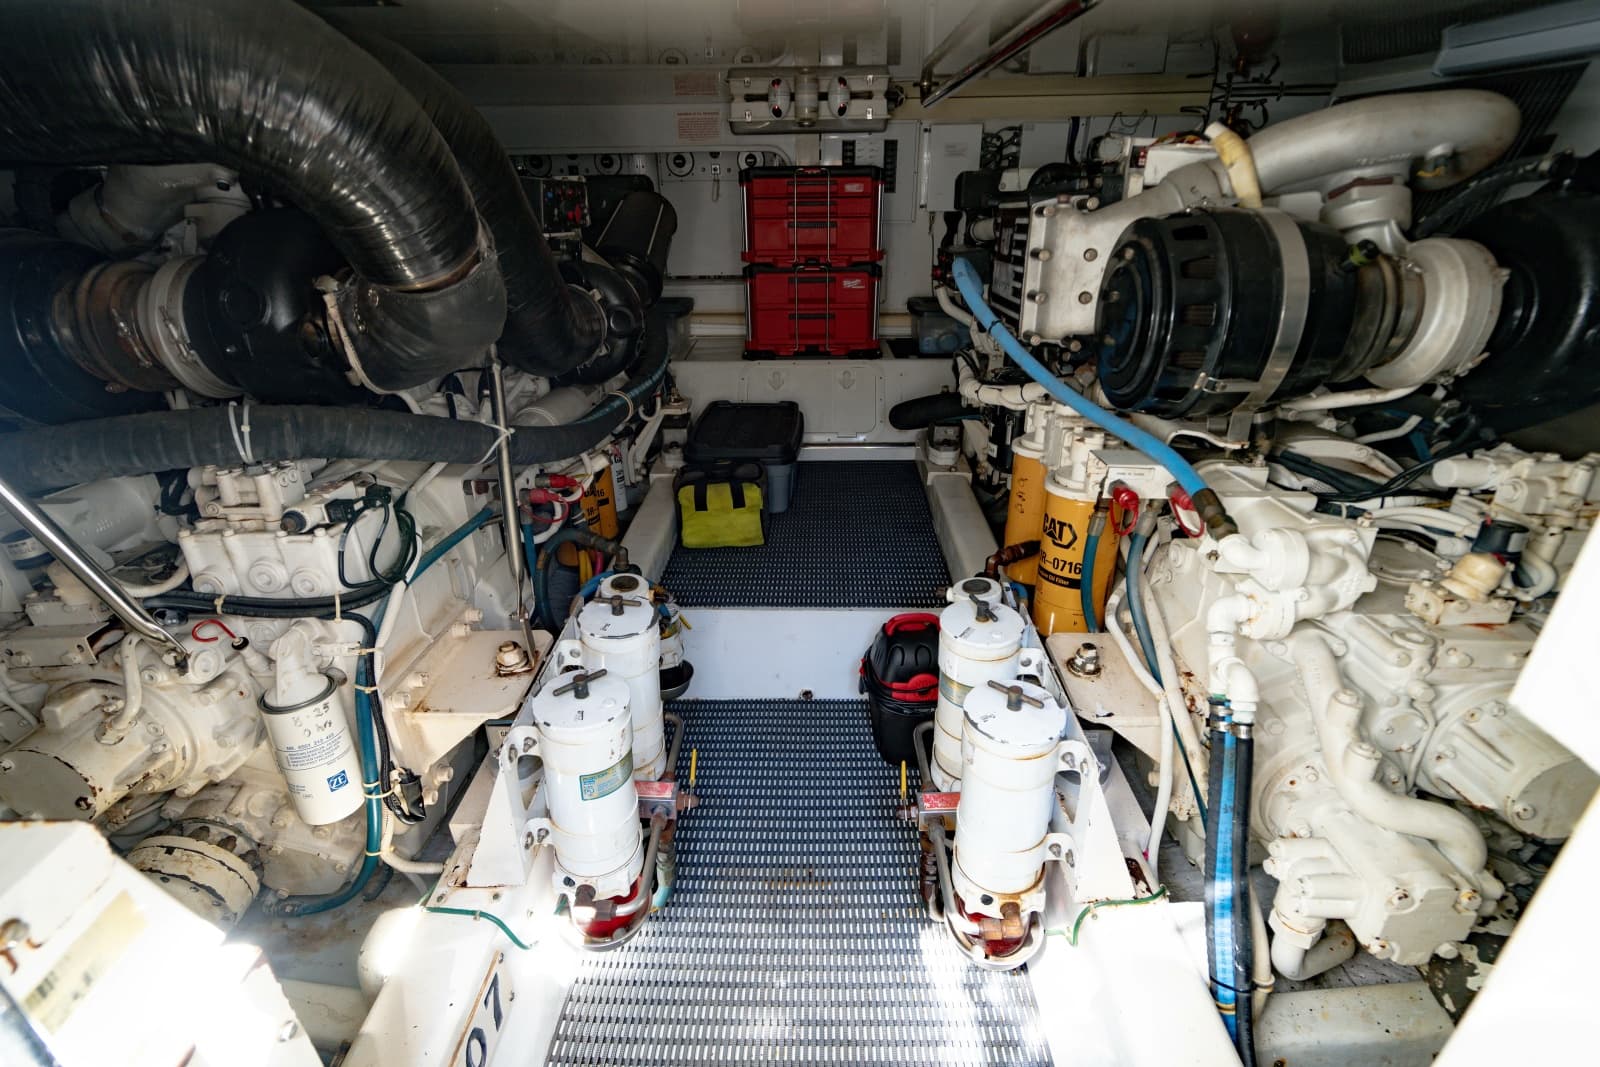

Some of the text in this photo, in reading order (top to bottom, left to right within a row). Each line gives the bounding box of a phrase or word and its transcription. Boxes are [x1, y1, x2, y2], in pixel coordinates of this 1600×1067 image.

[1042, 512, 1068, 542] CAT
[1055, 577, 1070, 585] Filter
[331, 773, 347, 789] ZF
